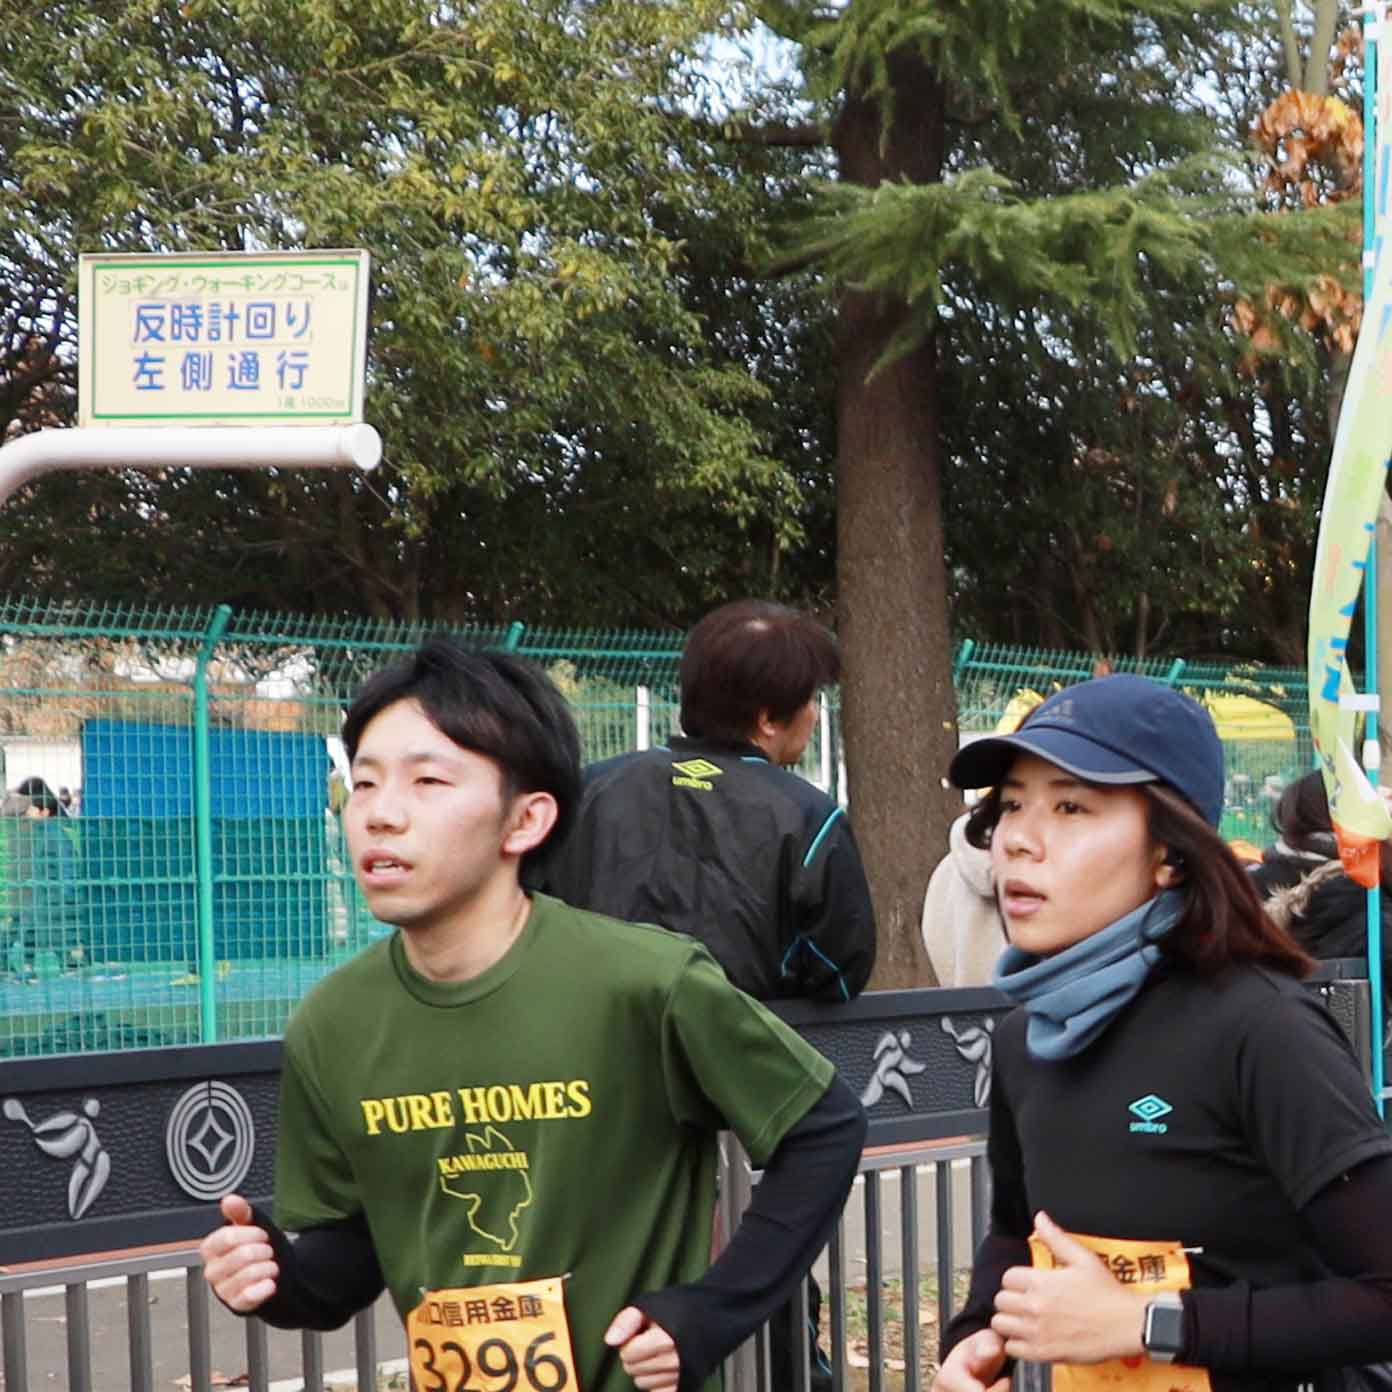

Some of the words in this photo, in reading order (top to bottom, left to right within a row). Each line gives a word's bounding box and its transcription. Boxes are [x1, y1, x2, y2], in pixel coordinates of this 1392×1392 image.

[133, 301, 312, 342] 反時計回り
[132, 351, 310, 391] 左側通行
[361, 1091, 455, 1135] PURE
[457, 1080, 592, 1124] HOMES
[1129, 1121, 1167, 1134] umbro
[438, 1151, 529, 1174] KAWAGUCHI
